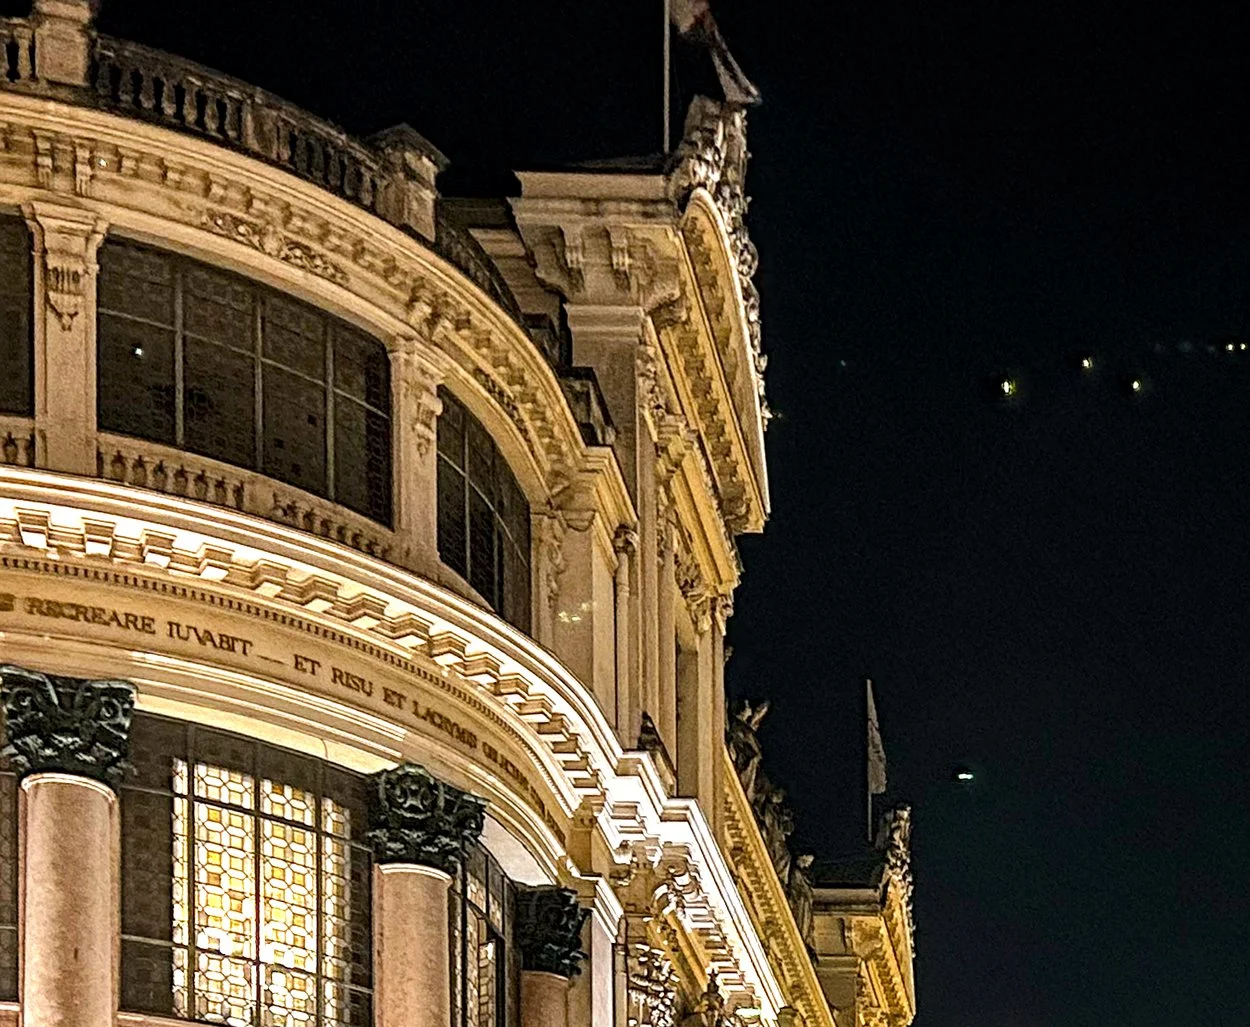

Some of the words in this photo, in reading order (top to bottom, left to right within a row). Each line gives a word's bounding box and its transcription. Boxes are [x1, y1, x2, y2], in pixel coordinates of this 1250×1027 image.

[26, 597, 156, 634] RECREARE
[167, 621, 254, 657] IUVABIT
[293, 654, 321, 676] ET
[331, 666, 374, 697] RISU
[382, 686, 407, 710] ET
